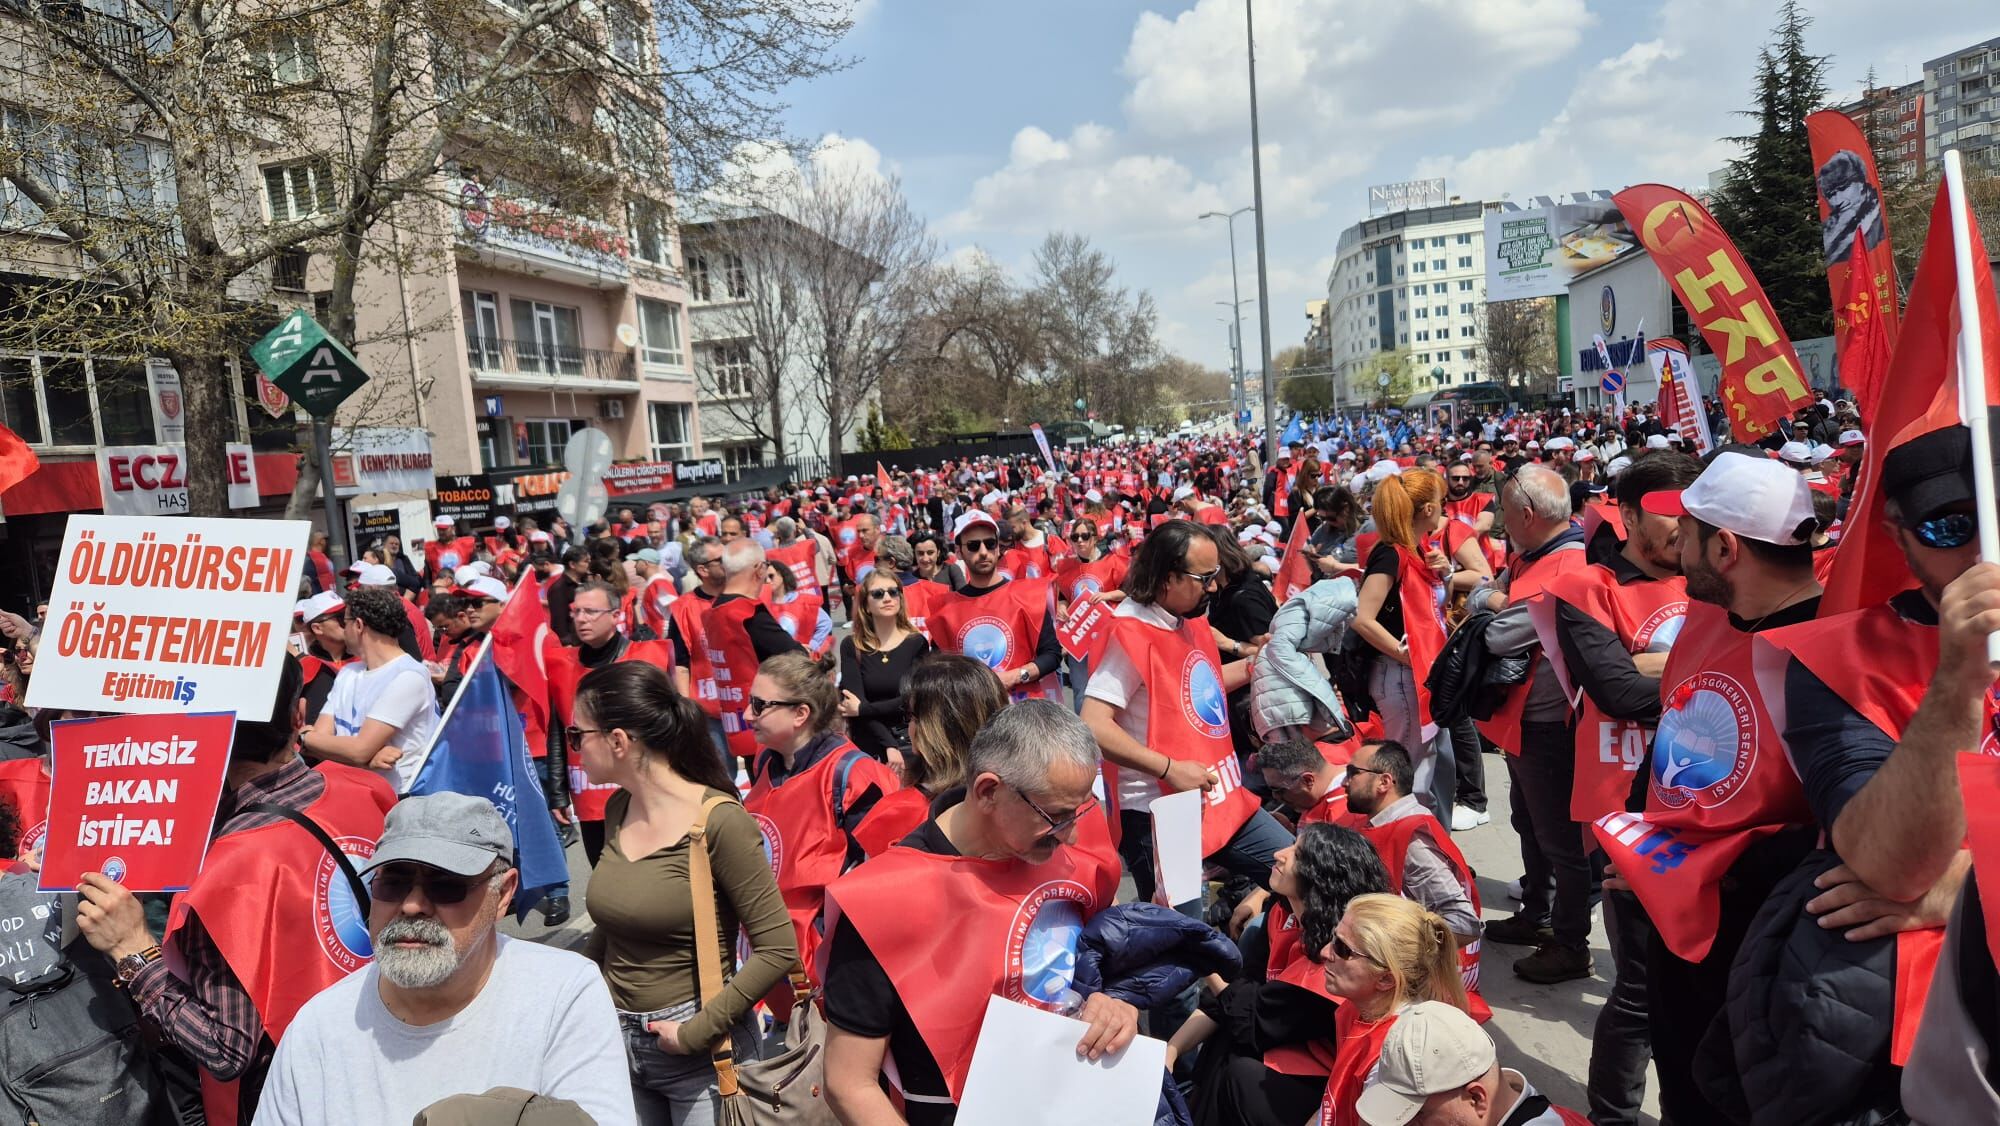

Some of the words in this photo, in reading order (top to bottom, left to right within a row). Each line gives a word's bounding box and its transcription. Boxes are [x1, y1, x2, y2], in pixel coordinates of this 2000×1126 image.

[360, 454, 400, 473] KENNETH
[401, 453, 433, 470] BURGER
[438, 488, 491, 503] TOBACCO
[454, 476, 472, 487] YK
[68, 530, 294, 593] ÖLDÜRÜRSEN
[1060, 600, 1091, 634] YETER
[57, 601, 272, 668] ÖĞRETEMEM
[102, 671, 197, 706] Eğitimiş
[83, 735, 198, 769] TEKİNSİZ
[1712, 733, 1751, 798] SENDİKASI
[85, 778, 178, 805] BAKAN
[77, 813, 175, 847] İSTİFA!
[327, 935, 356, 968] EĞİTİM
[1012, 923, 1028, 966] BİLİM
